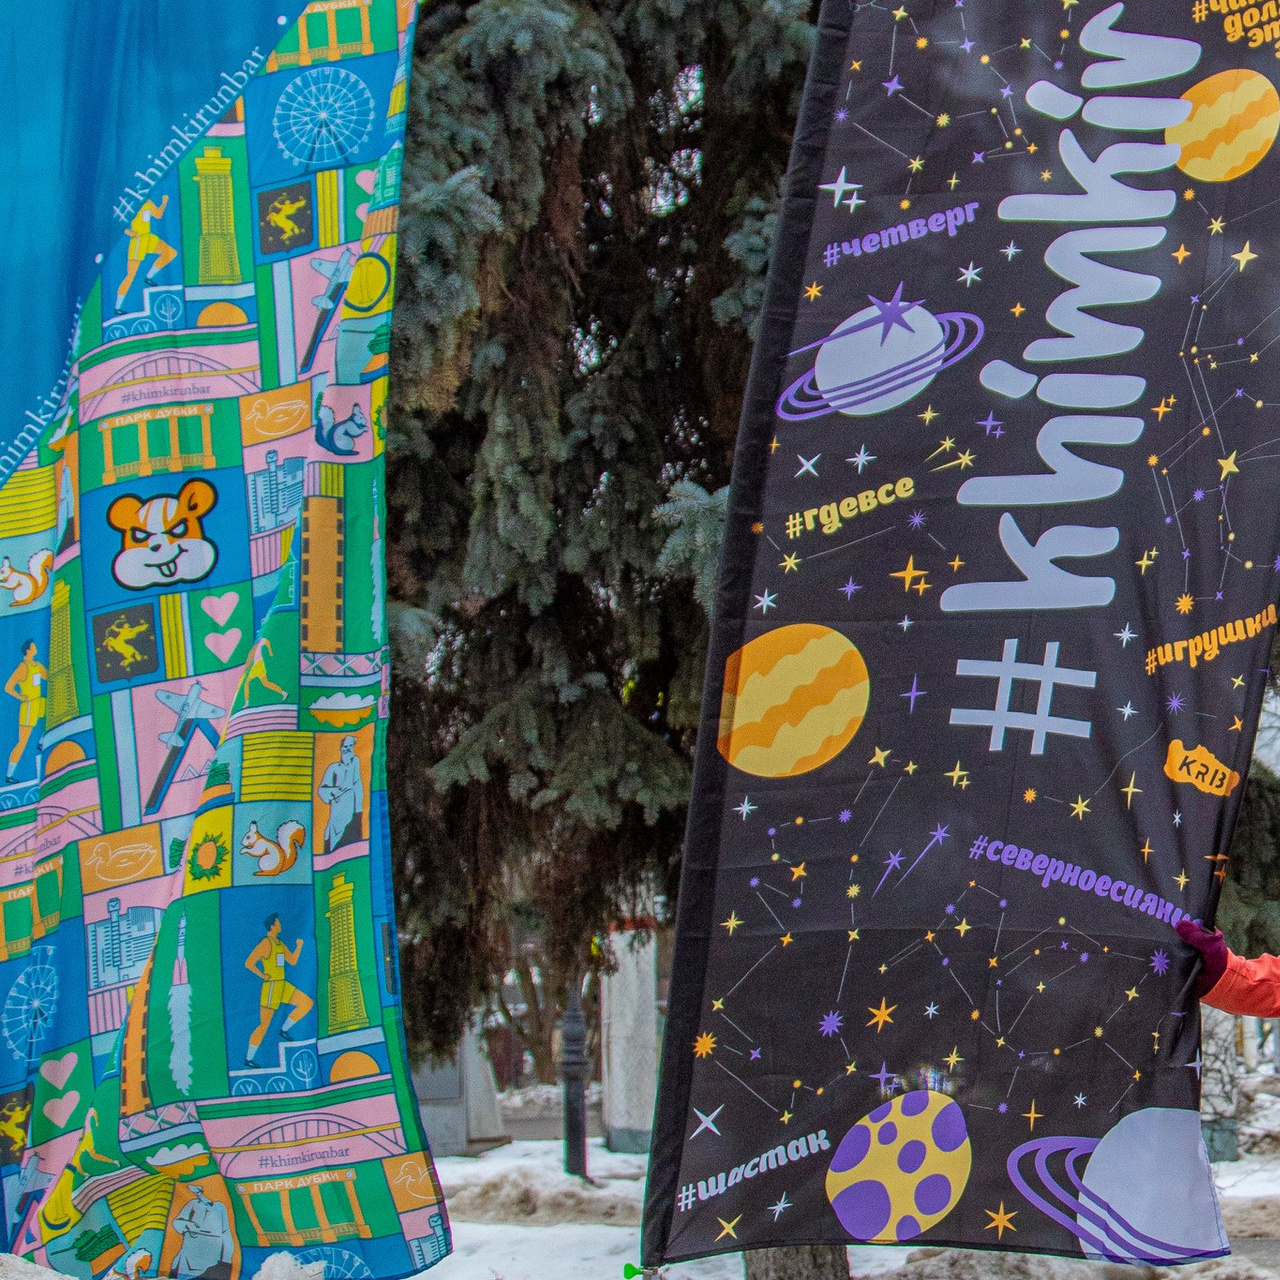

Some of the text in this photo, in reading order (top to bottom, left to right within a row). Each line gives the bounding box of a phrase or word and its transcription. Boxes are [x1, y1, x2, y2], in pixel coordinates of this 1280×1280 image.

[112, 45, 266, 224] #khimkirunbar
[822, 200, 980, 268] #четверг
[114, 410, 152, 426] ПАРК
[785, 475, 915, 539] #гдевсе
[1145, 603, 1278, 676] #игрушки
[968, 834, 1204, 928] #северноесияни
[253, 1171, 340, 1192] ПАРК ДУБКИ
[258, 1146, 350, 1169] #khimkirunbar
